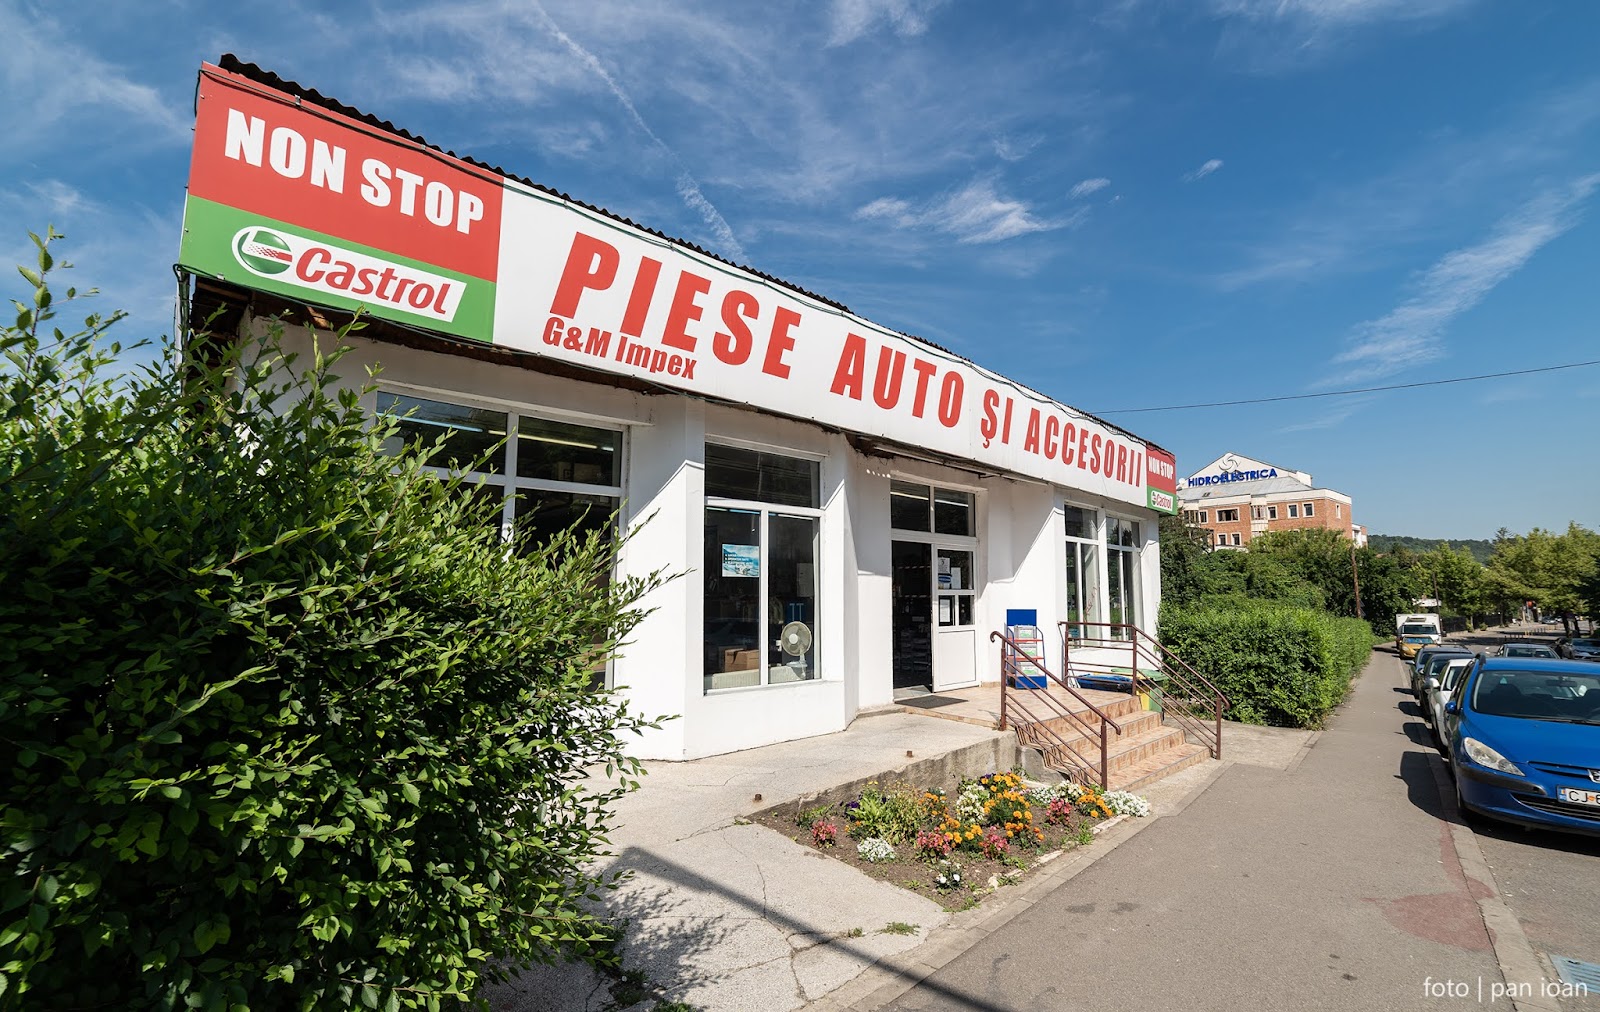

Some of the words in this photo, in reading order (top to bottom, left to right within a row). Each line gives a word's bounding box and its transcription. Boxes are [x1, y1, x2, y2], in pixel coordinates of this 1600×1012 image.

[225, 108, 347, 194] NON
[360, 158, 484, 235] STOP
[296, 247, 451, 314] Castrol
[542, 316, 612, 358] G&M
[615, 335, 697, 381] Impex
[550, 232, 801, 379] PIESE
[830, 332, 965, 428] AUTO
[1024, 408, 1142, 487] ACCESORII
[1156, 493, 1172, 509] Castrol
[1160, 460, 1174, 480] STOP
[1188, 468, 1278, 487] HIDROELECTRICA
